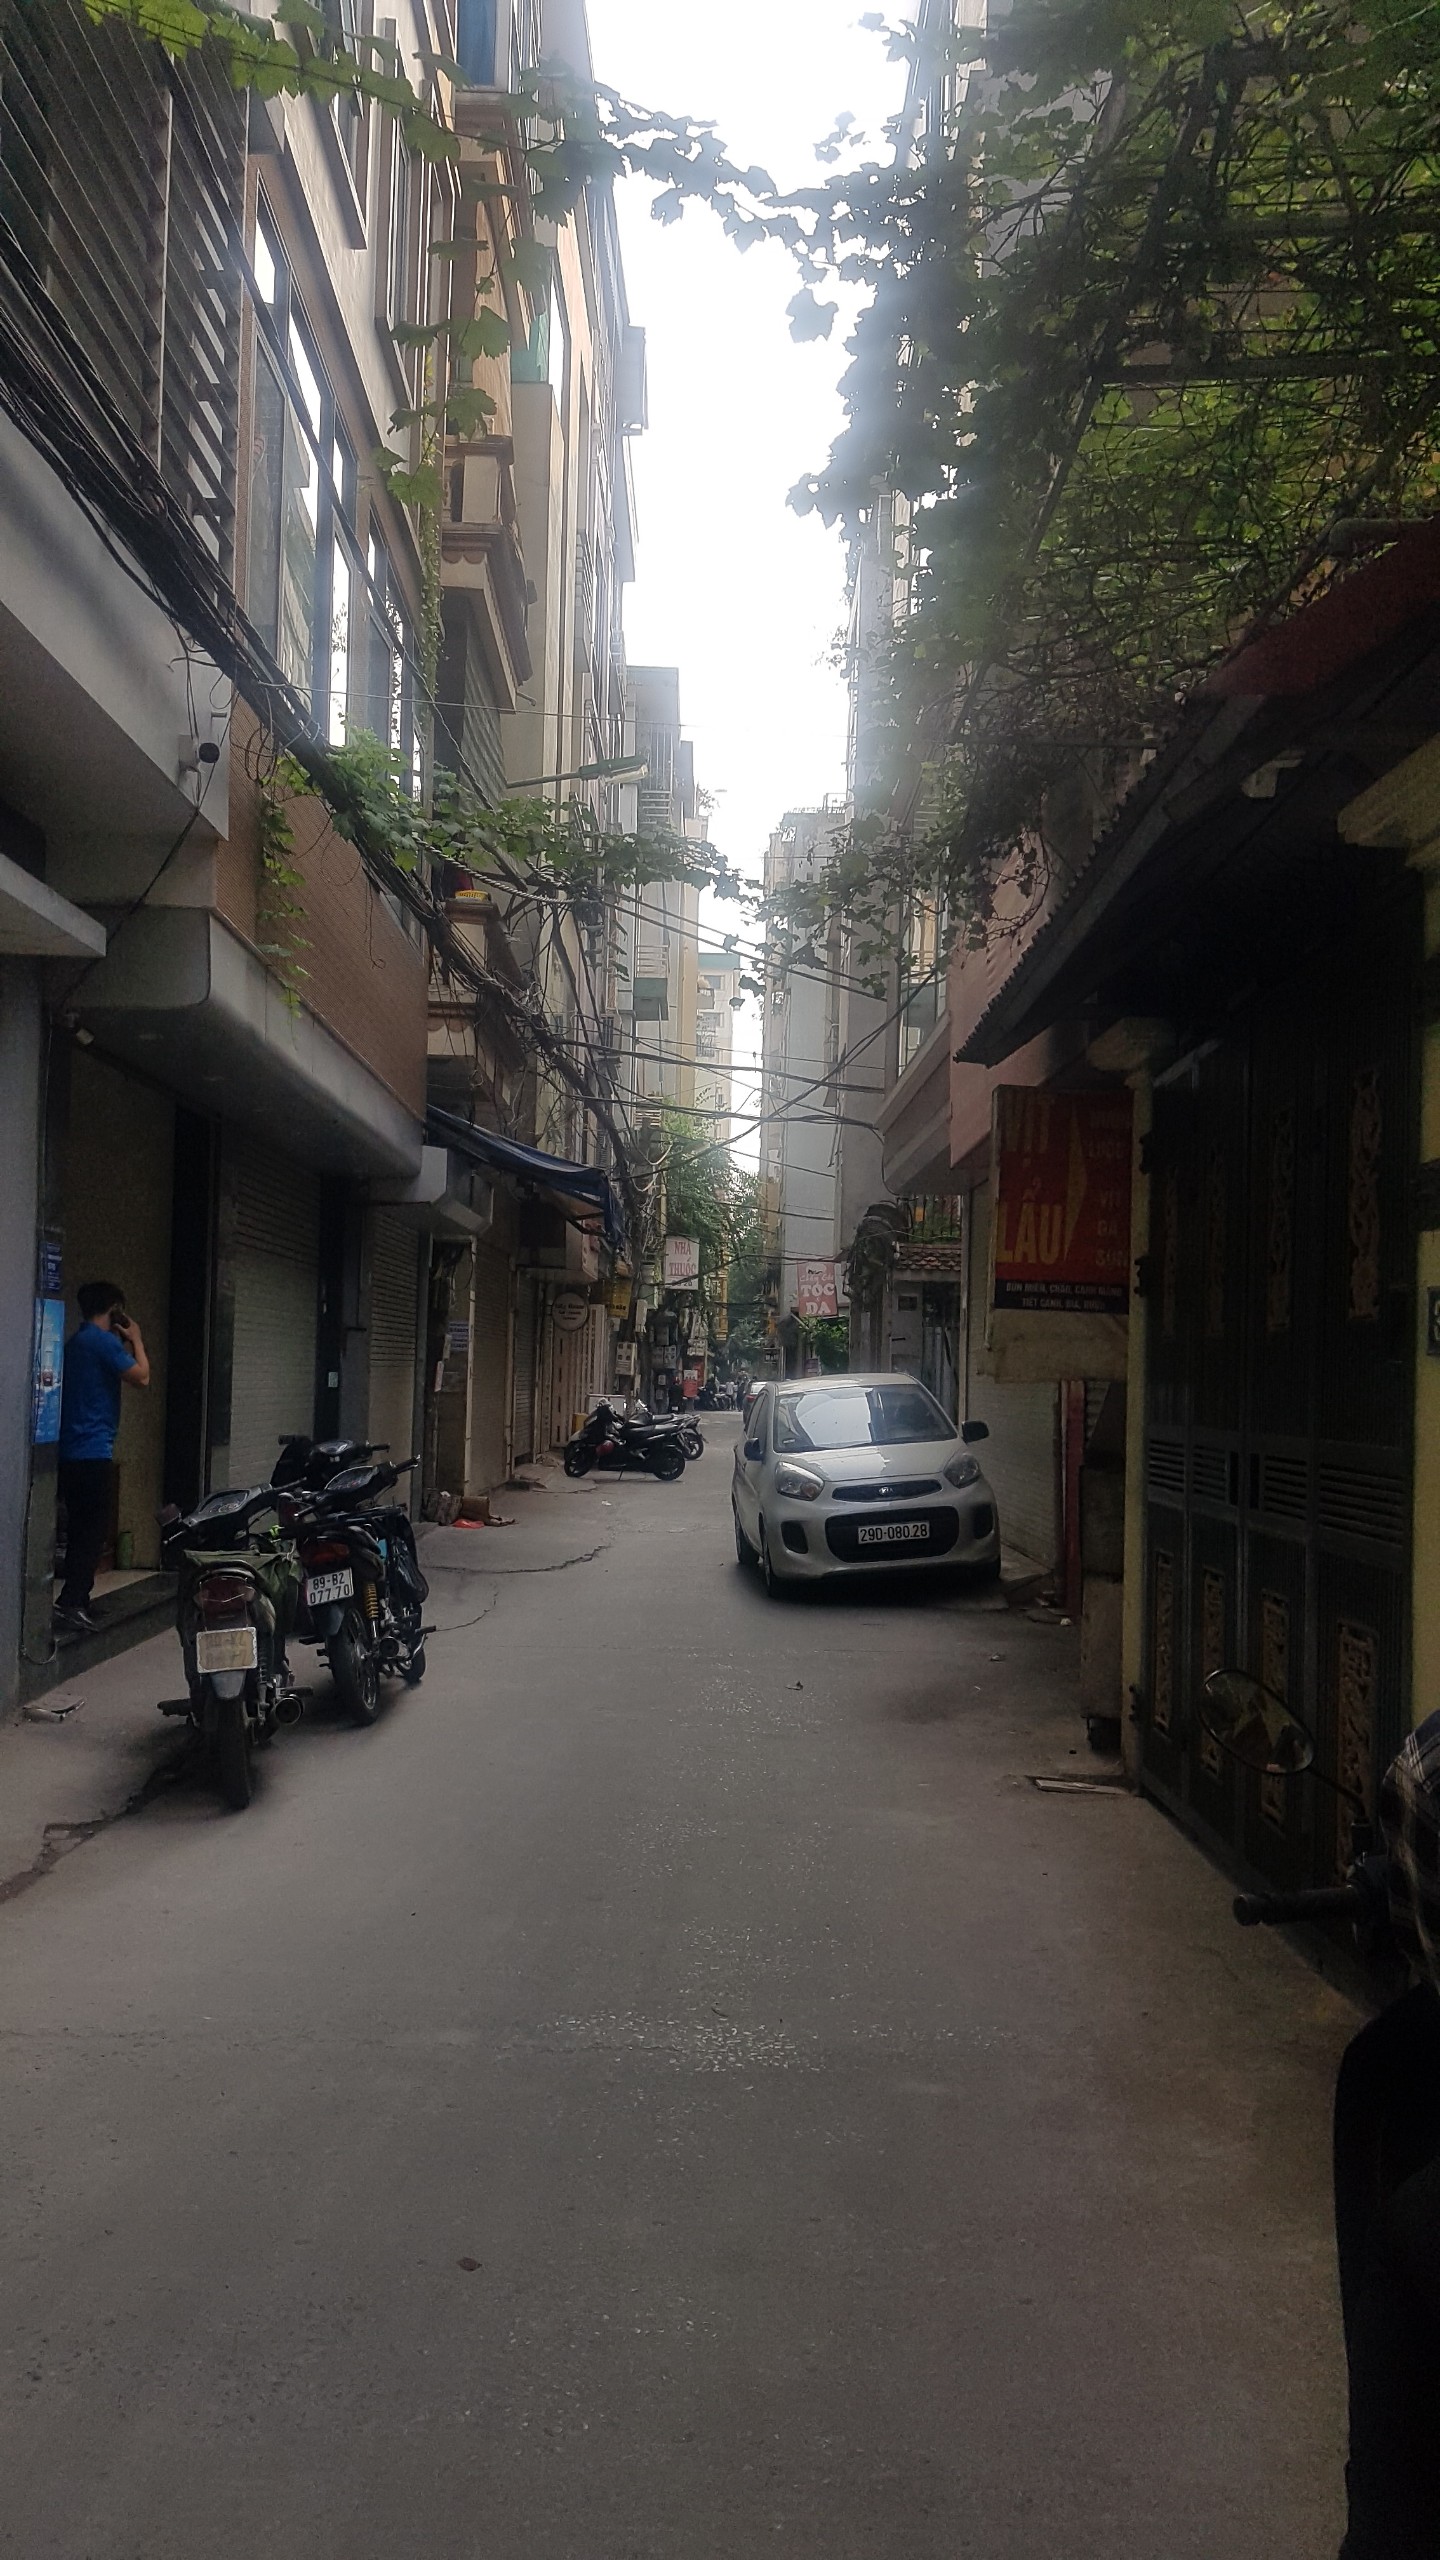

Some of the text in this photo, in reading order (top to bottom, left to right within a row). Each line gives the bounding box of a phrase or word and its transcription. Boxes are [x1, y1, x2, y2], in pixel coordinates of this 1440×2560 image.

[860, 1524, 928, 1542] 29D-080.28
[313, 1572, 345, 1590] 89-B2
[310, 1584, 350, 1604] 077.70
